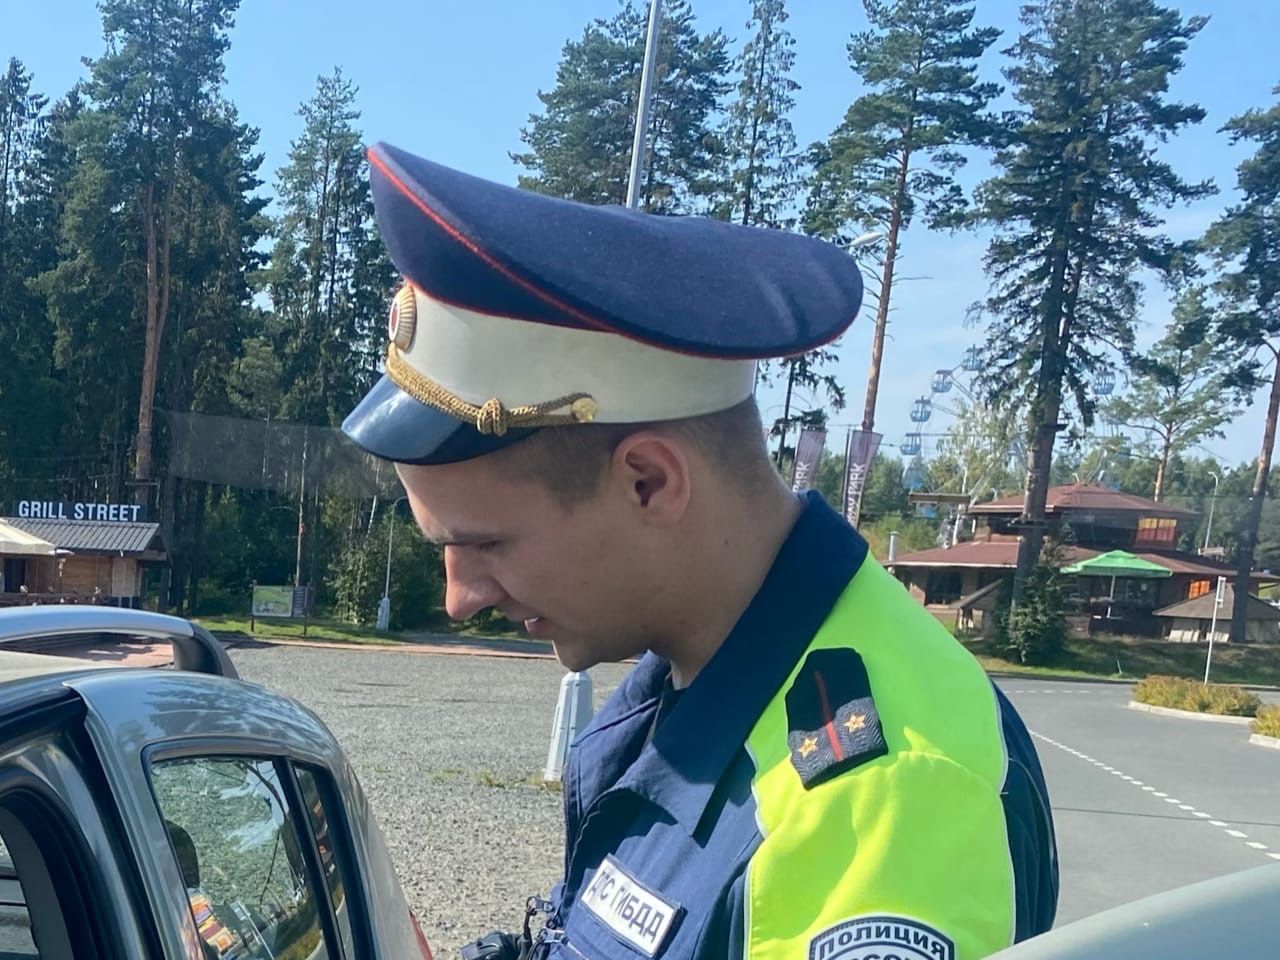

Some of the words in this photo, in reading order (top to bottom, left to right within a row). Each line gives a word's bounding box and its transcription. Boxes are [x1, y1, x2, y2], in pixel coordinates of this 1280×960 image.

[848, 462, 865, 494] PARK
[18, 500, 67, 520] GRILL
[74, 502, 141, 522] STREET
[609, 886, 665, 943] ГИБДД
